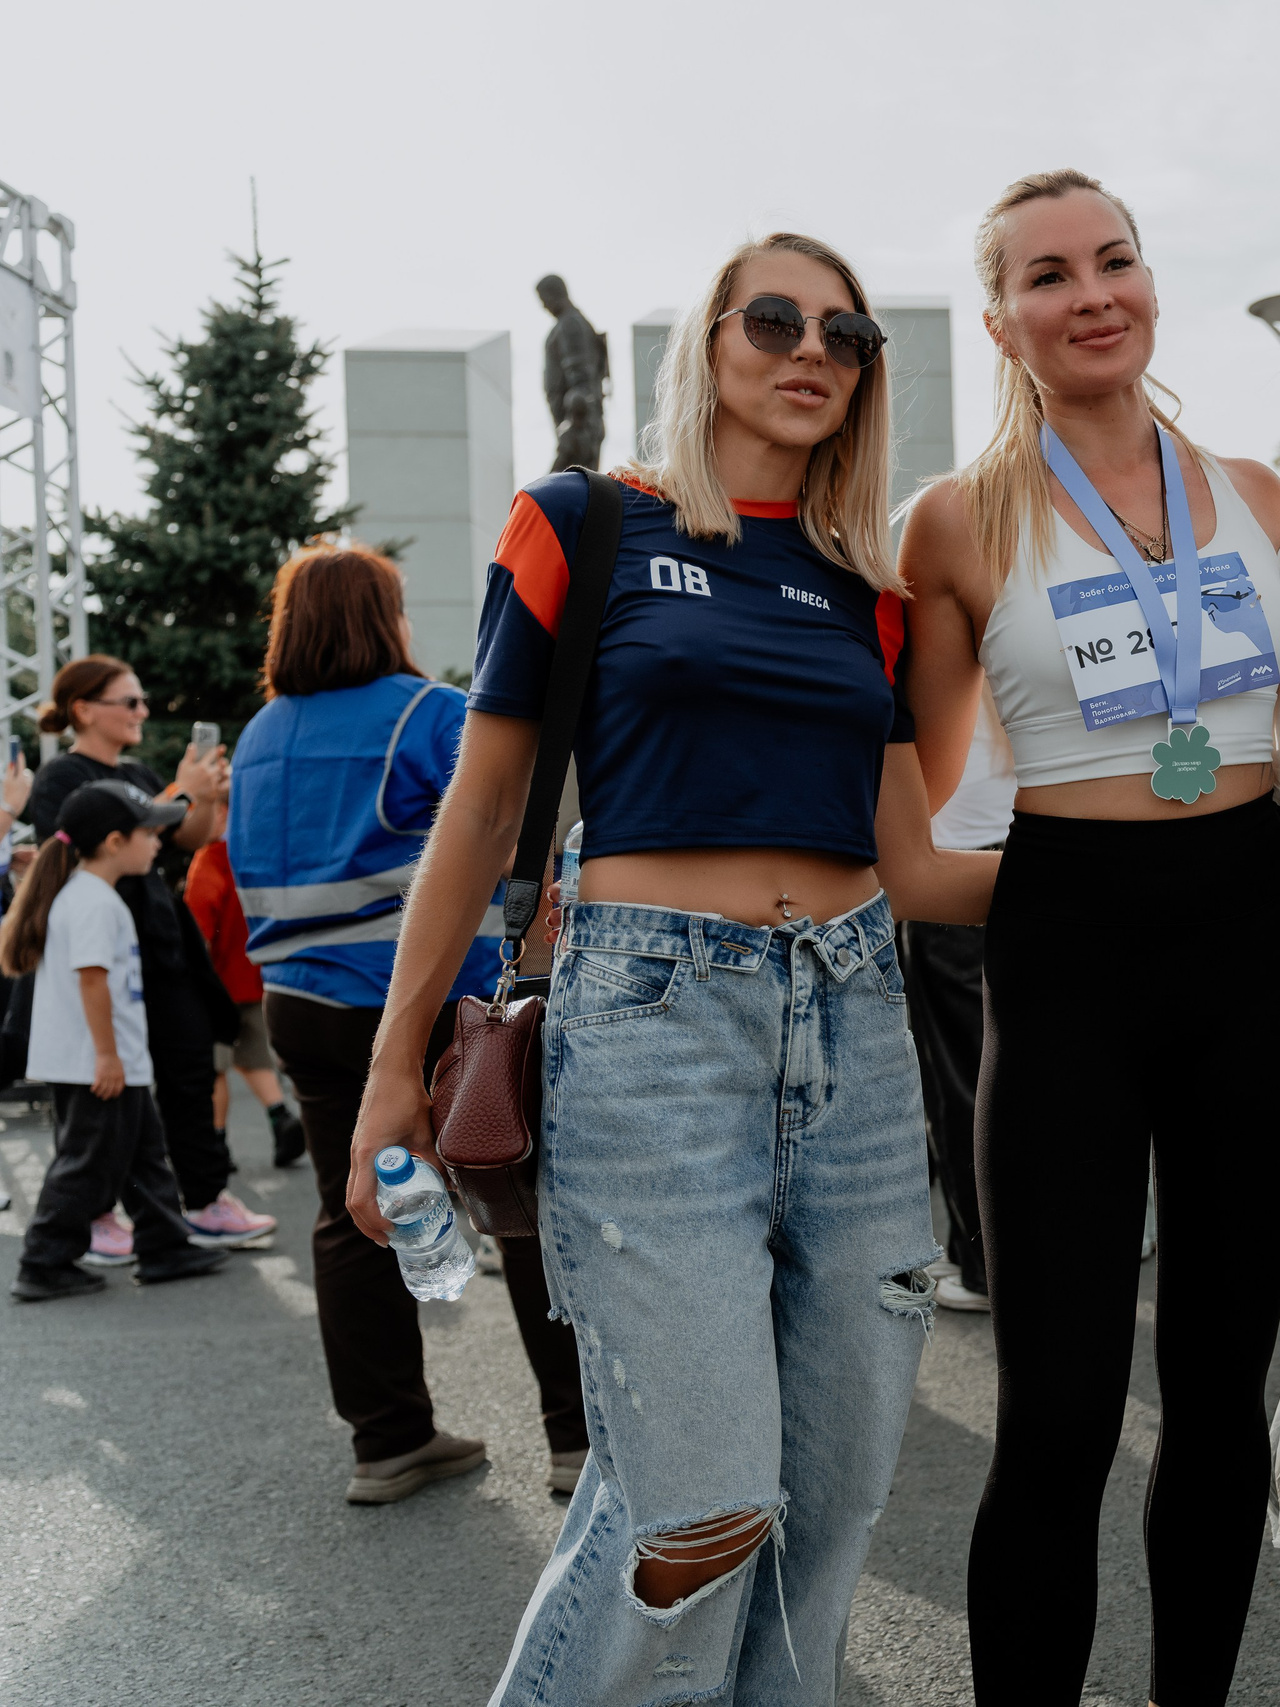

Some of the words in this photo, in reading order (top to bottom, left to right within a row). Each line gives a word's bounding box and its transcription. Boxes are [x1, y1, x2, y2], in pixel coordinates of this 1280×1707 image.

[649, 556, 712, 597] 08
[1079, 587, 1106, 599] Забег
[1205, 563, 1231, 574] Урала
[780, 584, 831, 611] TRIBECA
